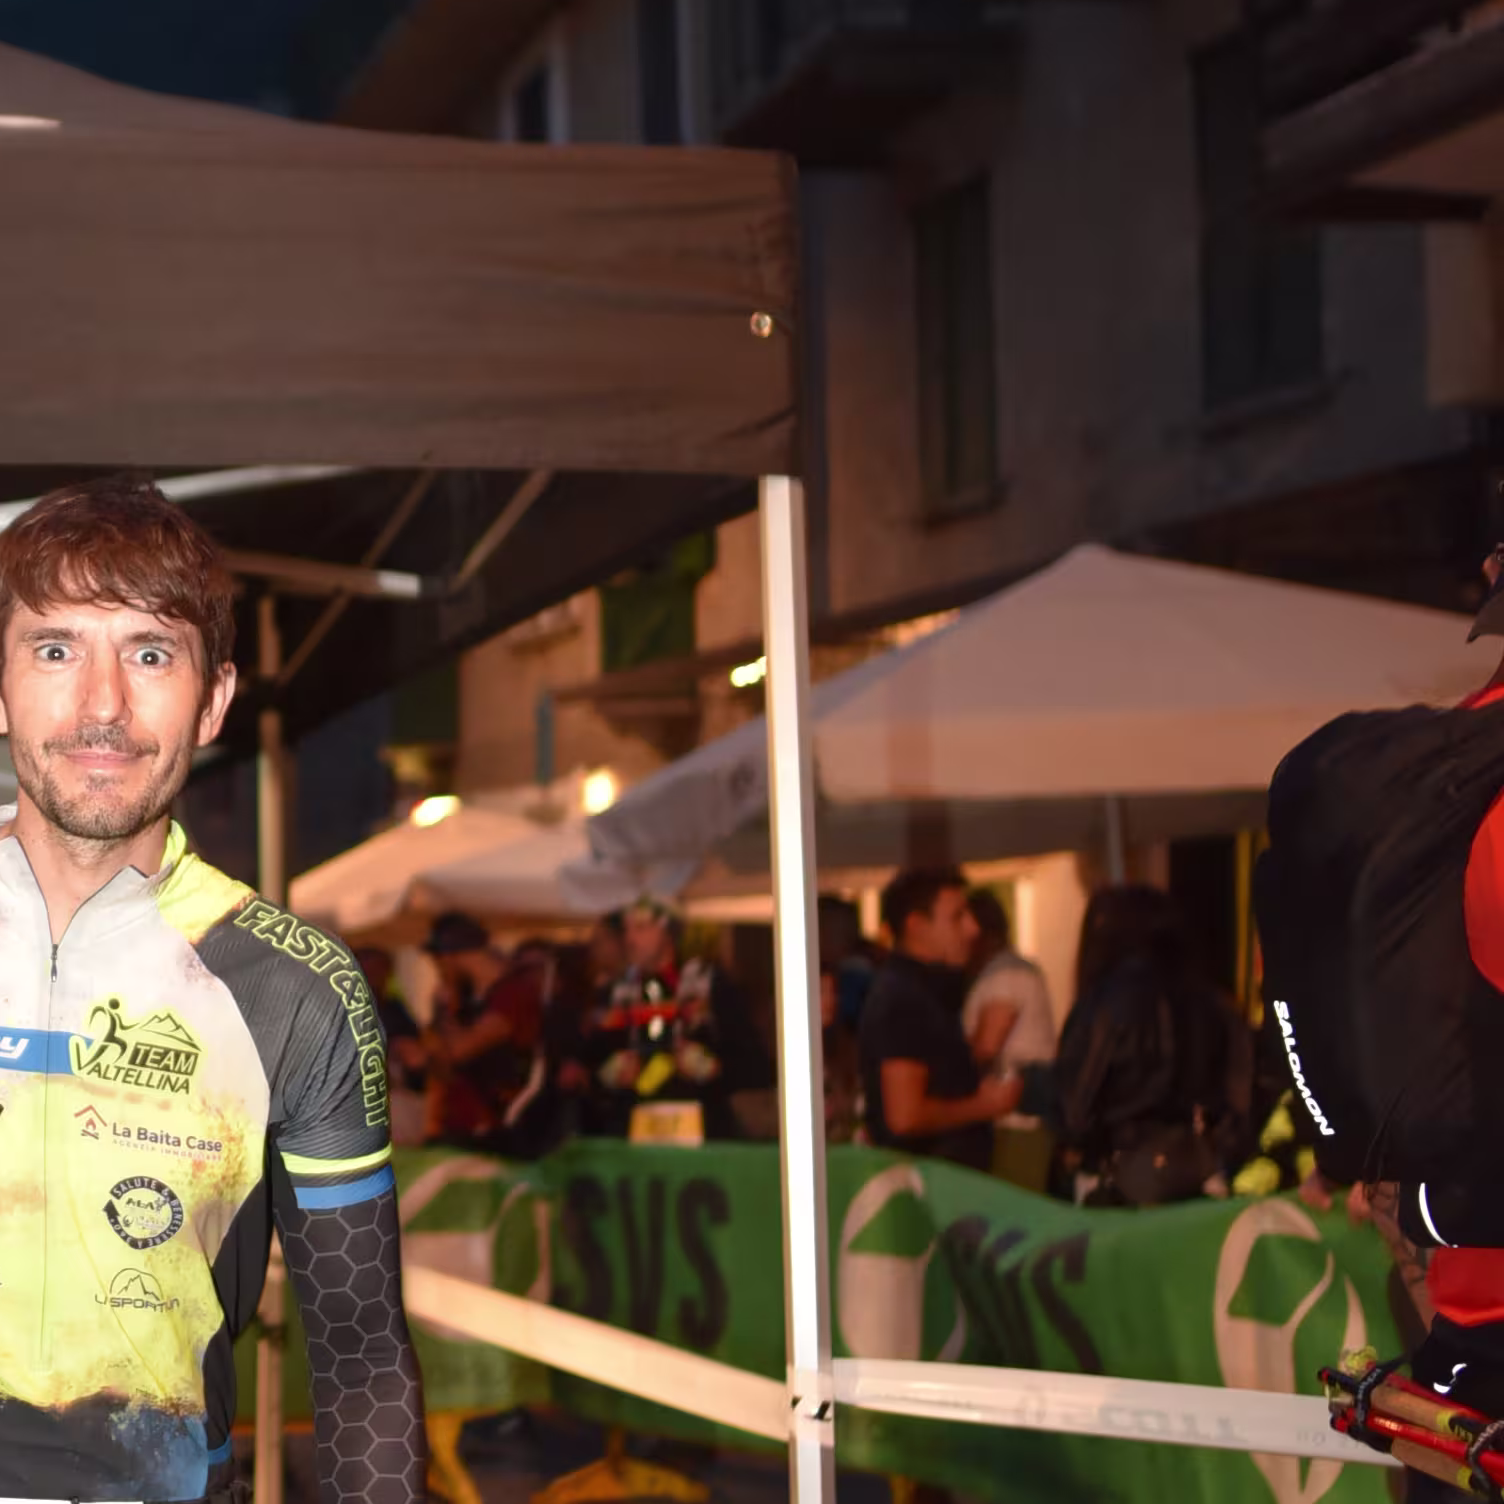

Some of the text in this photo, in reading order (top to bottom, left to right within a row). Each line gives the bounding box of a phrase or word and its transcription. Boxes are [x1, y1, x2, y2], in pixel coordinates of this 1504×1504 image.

[75, 1042, 190, 1095] VALTELLINA
[135, 1045, 196, 1076] TEAM
[1273, 999, 1335, 1137] SALOMON
[112, 1122, 223, 1152] La Baita Case
[112, 1177, 158, 1197] SALUTE
